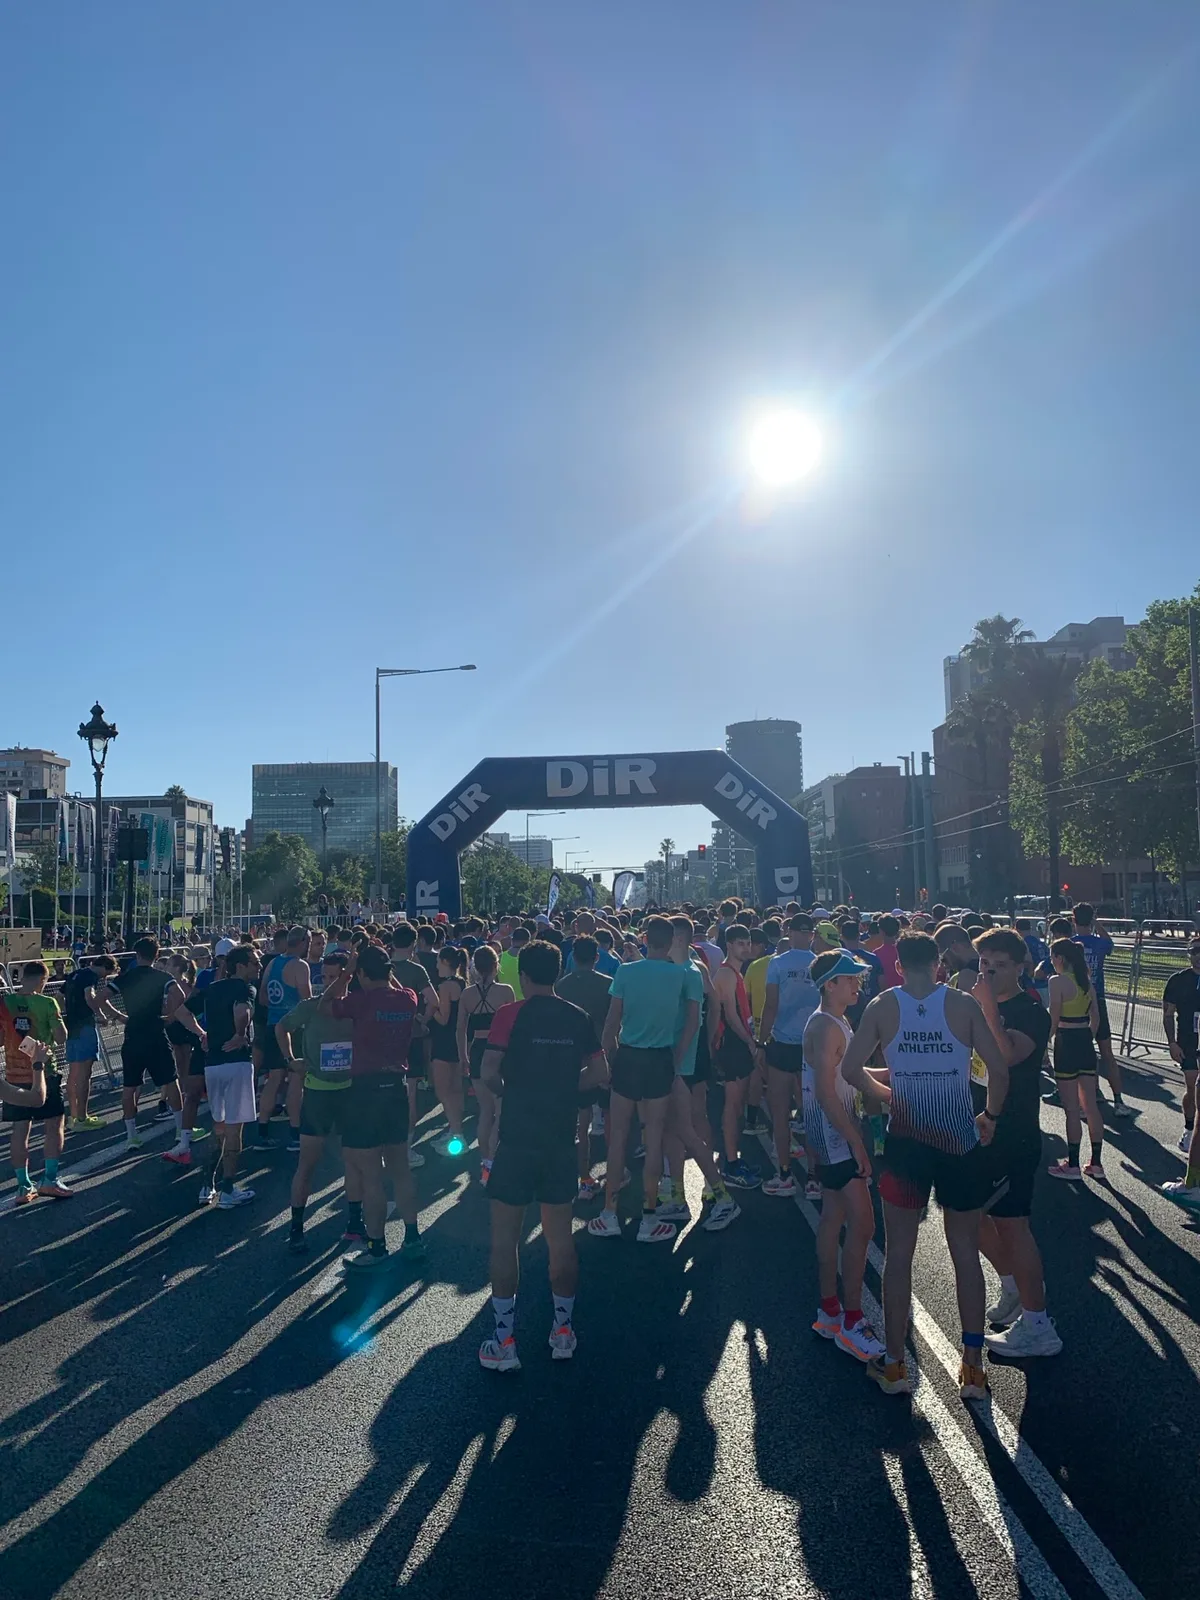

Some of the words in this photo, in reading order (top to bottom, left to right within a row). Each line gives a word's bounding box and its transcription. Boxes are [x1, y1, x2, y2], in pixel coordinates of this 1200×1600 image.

[546, 757, 658, 798] DiR
[428, 782, 492, 842] DiR
[714, 771, 778, 830] DiR
[897, 1042, 954, 1054] ATHLETICS
[903, 1031, 943, 1042] URBAN
